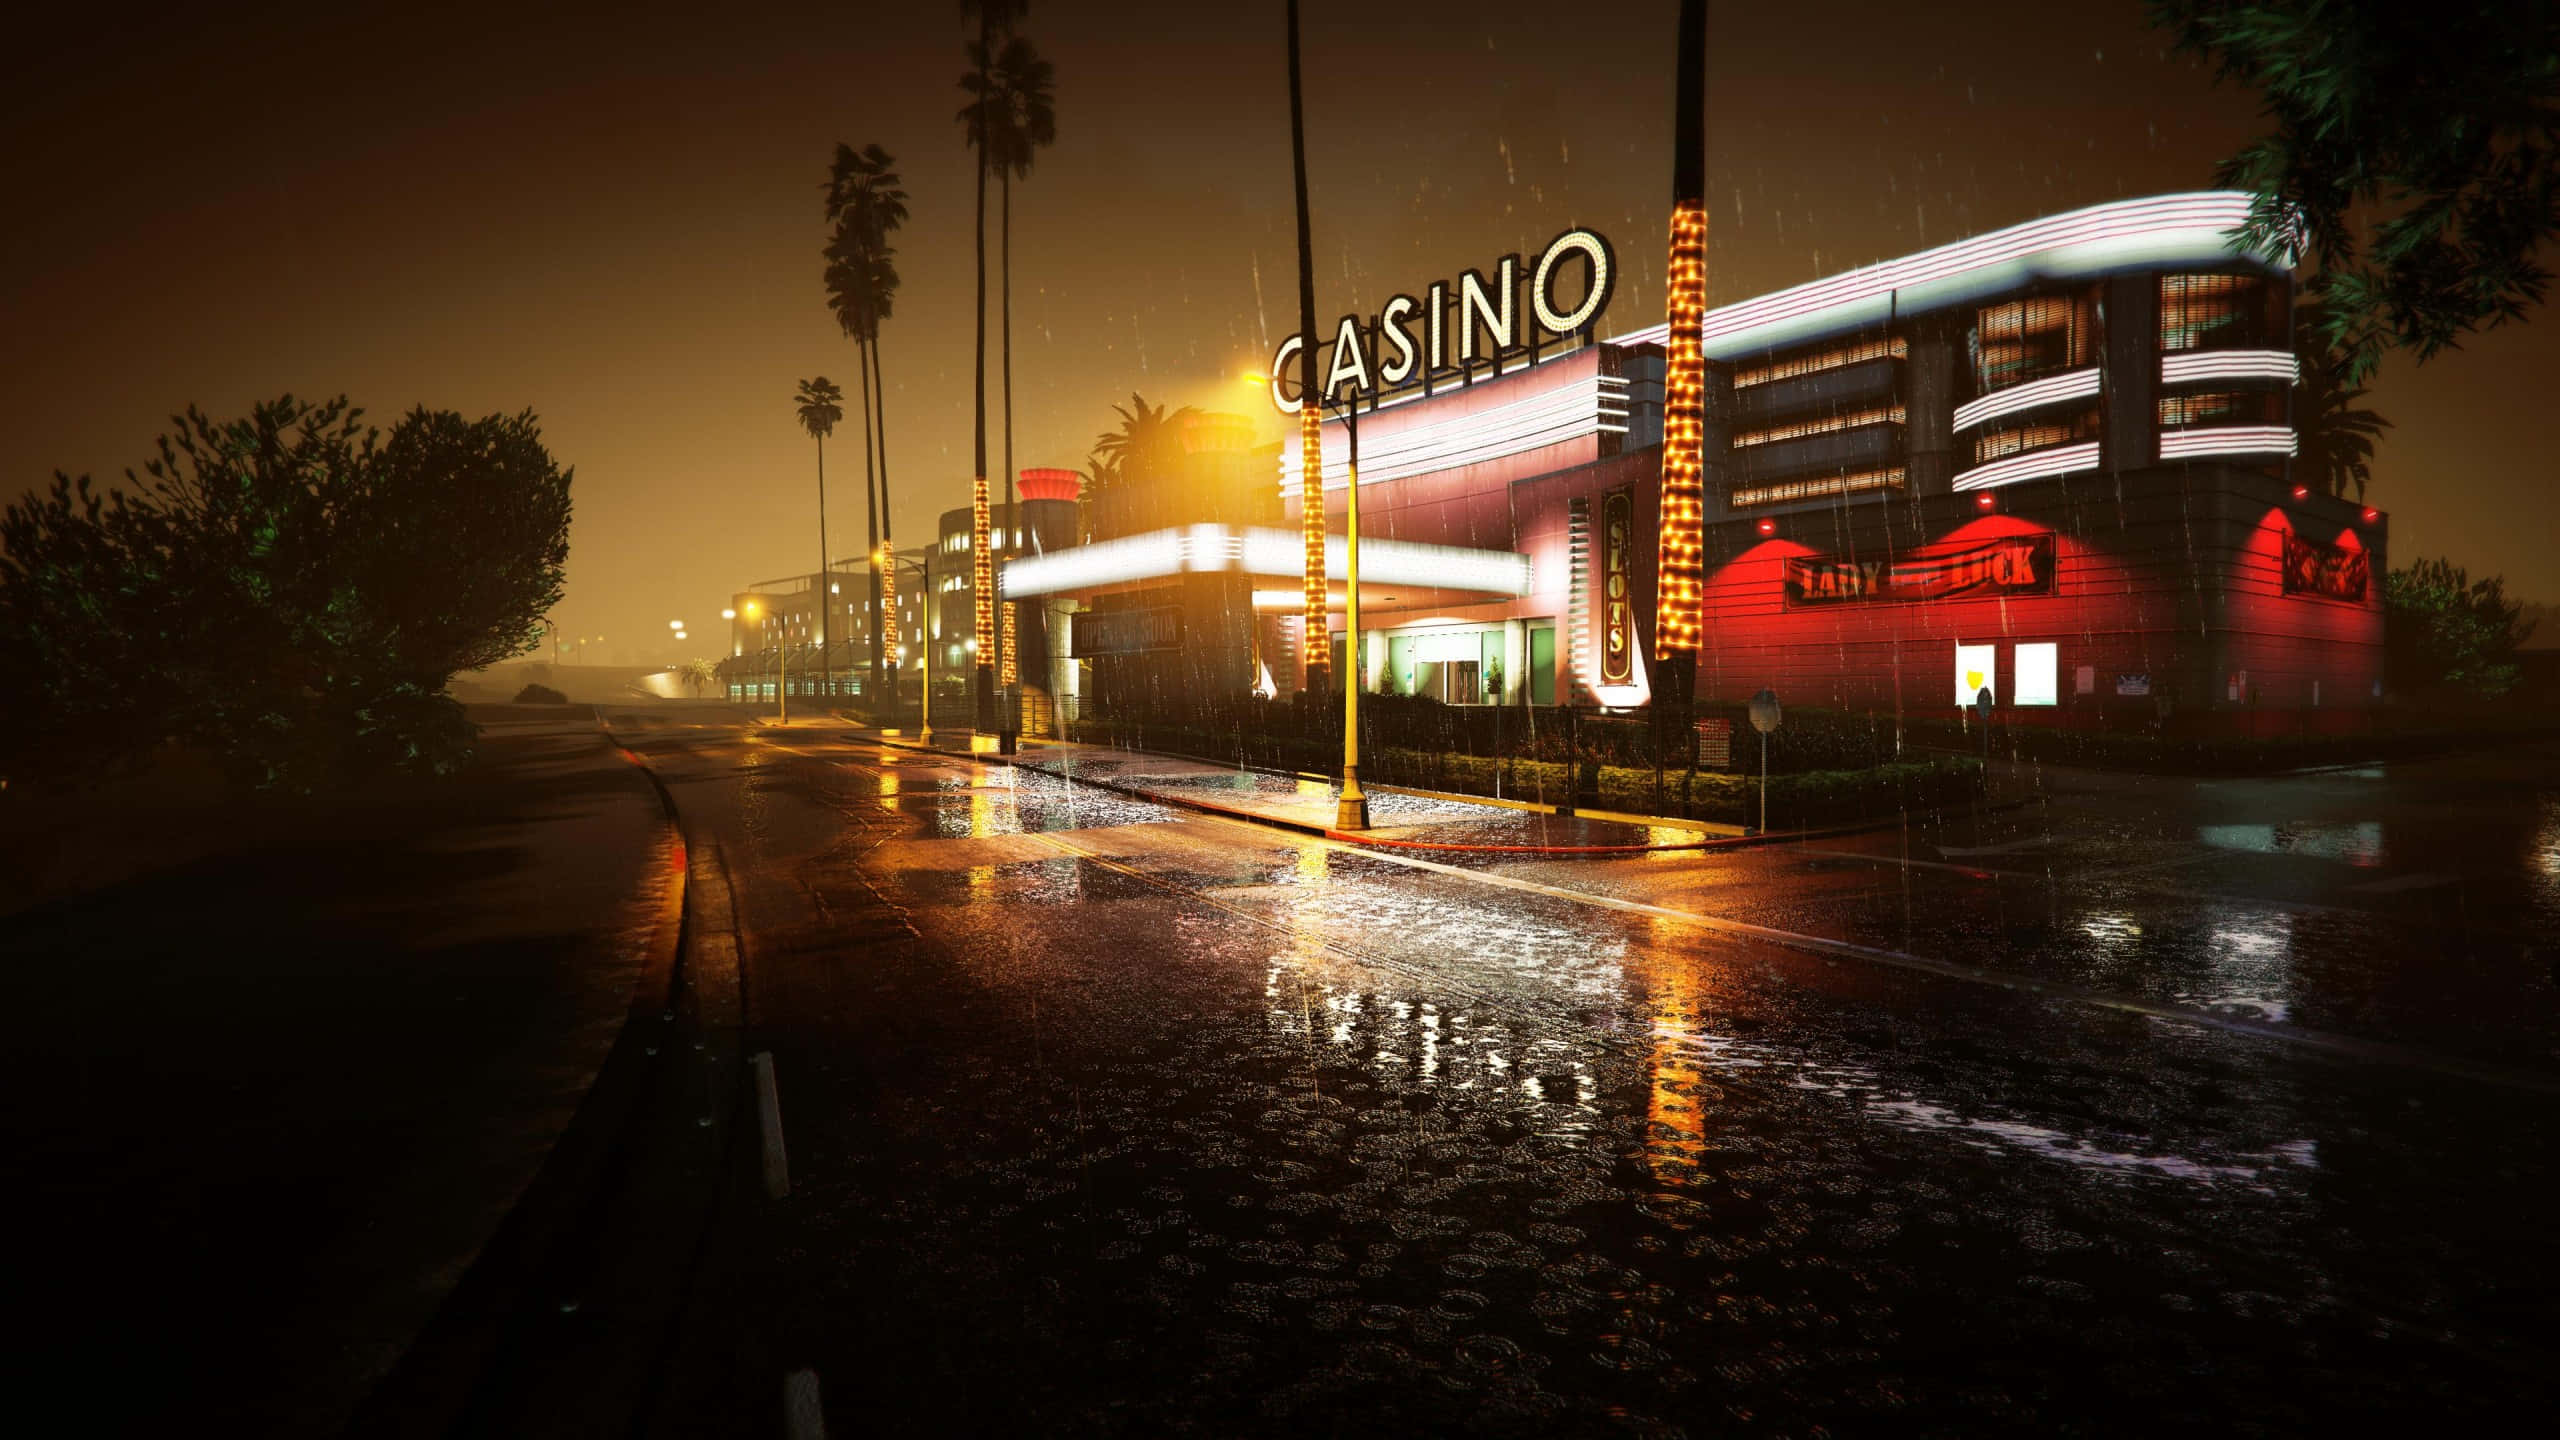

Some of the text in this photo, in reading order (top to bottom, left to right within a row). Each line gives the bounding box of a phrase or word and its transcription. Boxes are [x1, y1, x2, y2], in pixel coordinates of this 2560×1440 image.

[1272, 230, 1610, 414] CASINO
[1608, 521, 1625, 652] SLOTS
[1800, 546, 2036, 599] LADY LUCK
